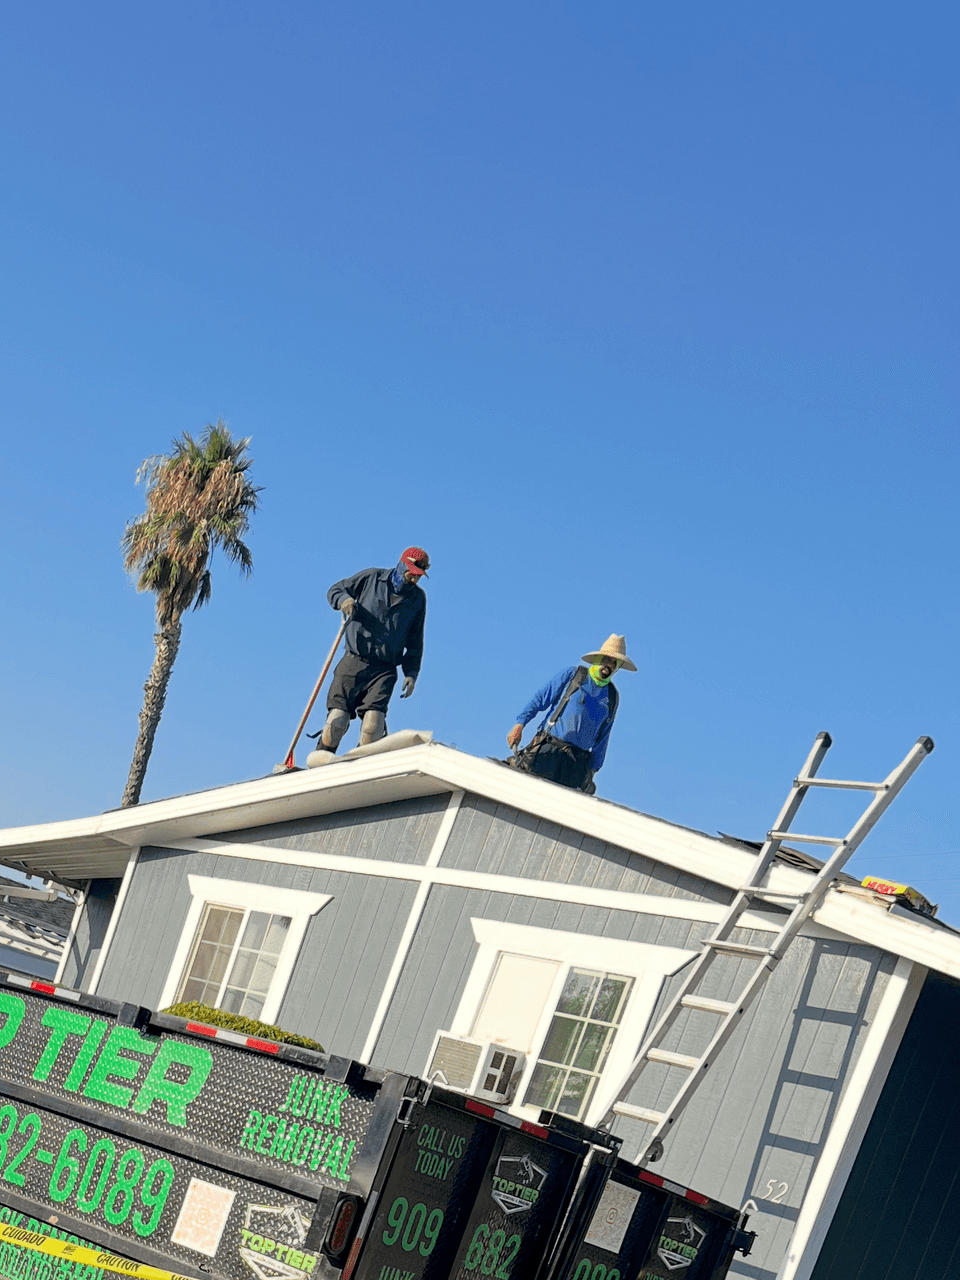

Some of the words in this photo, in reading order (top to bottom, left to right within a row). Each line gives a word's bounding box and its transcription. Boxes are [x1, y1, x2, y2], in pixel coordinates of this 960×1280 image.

[32, 1007, 213, 1127] TIER
[278, 1074, 350, 1128] JUNK
[240, 1109, 356, 1183] REMOVAL
[414, 1149, 454, 1181] TODAY
[417, 1124, 446, 1153] CALL
[448, 1134, 466, 1159] US
[761, 1179, 789, 1204] 52
[1, 1226, 47, 1246] CUIDADO
[96, 1253, 142, 1273] CAUTION
[383, 1196, 444, 1257] 909
[465, 1223, 522, 1280] 682
